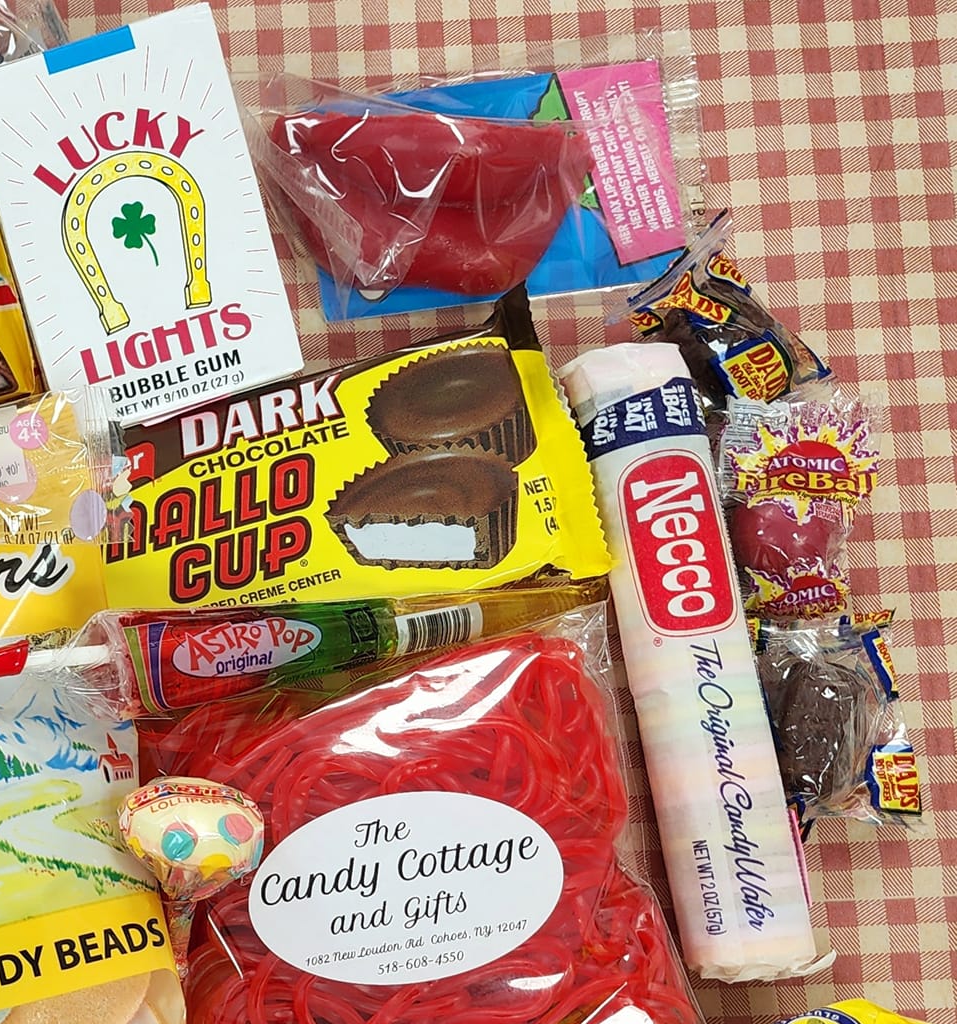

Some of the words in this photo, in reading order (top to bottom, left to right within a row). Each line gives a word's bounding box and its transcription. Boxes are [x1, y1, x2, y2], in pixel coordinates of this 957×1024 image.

[32, 108, 205, 197] LUCKY
[592, 144, 611, 176] NEVER
[626, 142, 644, 183] TALKING
[610, 154, 636, 207] CONSTANT
[79, 303, 252, 385] LIGHTS
[110, 365, 188, 402] BUBBLE
[194, 349, 242, 378] GUM
[163, 384, 189, 405] 9/10
[192, 379, 209, 395] OZ
[181, 375, 344, 459] DARK
[660, 385, 684, 428] 1847
[676, 384, 692, 427] SINCE
[188, 421, 350, 480] CHOCOLATE
[768, 456, 844, 471] ATOMIC
[169, 516, 312, 605] CUP
[630, 471, 716, 618] Necco
[287, 568, 342, 592] CENTER
[690, 639, 723, 683] The
[698, 682, 745, 784] Original
[355, 819, 411, 848] The
[261, 858, 380, 906] Candy
[398, 835, 539, 881] Cottage
[331, 901, 393, 935] and
[404, 890, 467, 929] Gifts
[57, 918, 165, 971] BEADS
[305, 954, 330, 967] 1082
[333, 949, 357, 962] New
[357, 942, 402, 959] Loudon
[405, 937, 424, 950] Rd
[431, 930, 471, 945] Cohoes,
[474, 925, 493, 942] NY
[496, 919, 528, 934] 12047
[377, 950, 465, 975] 518-608-4550
